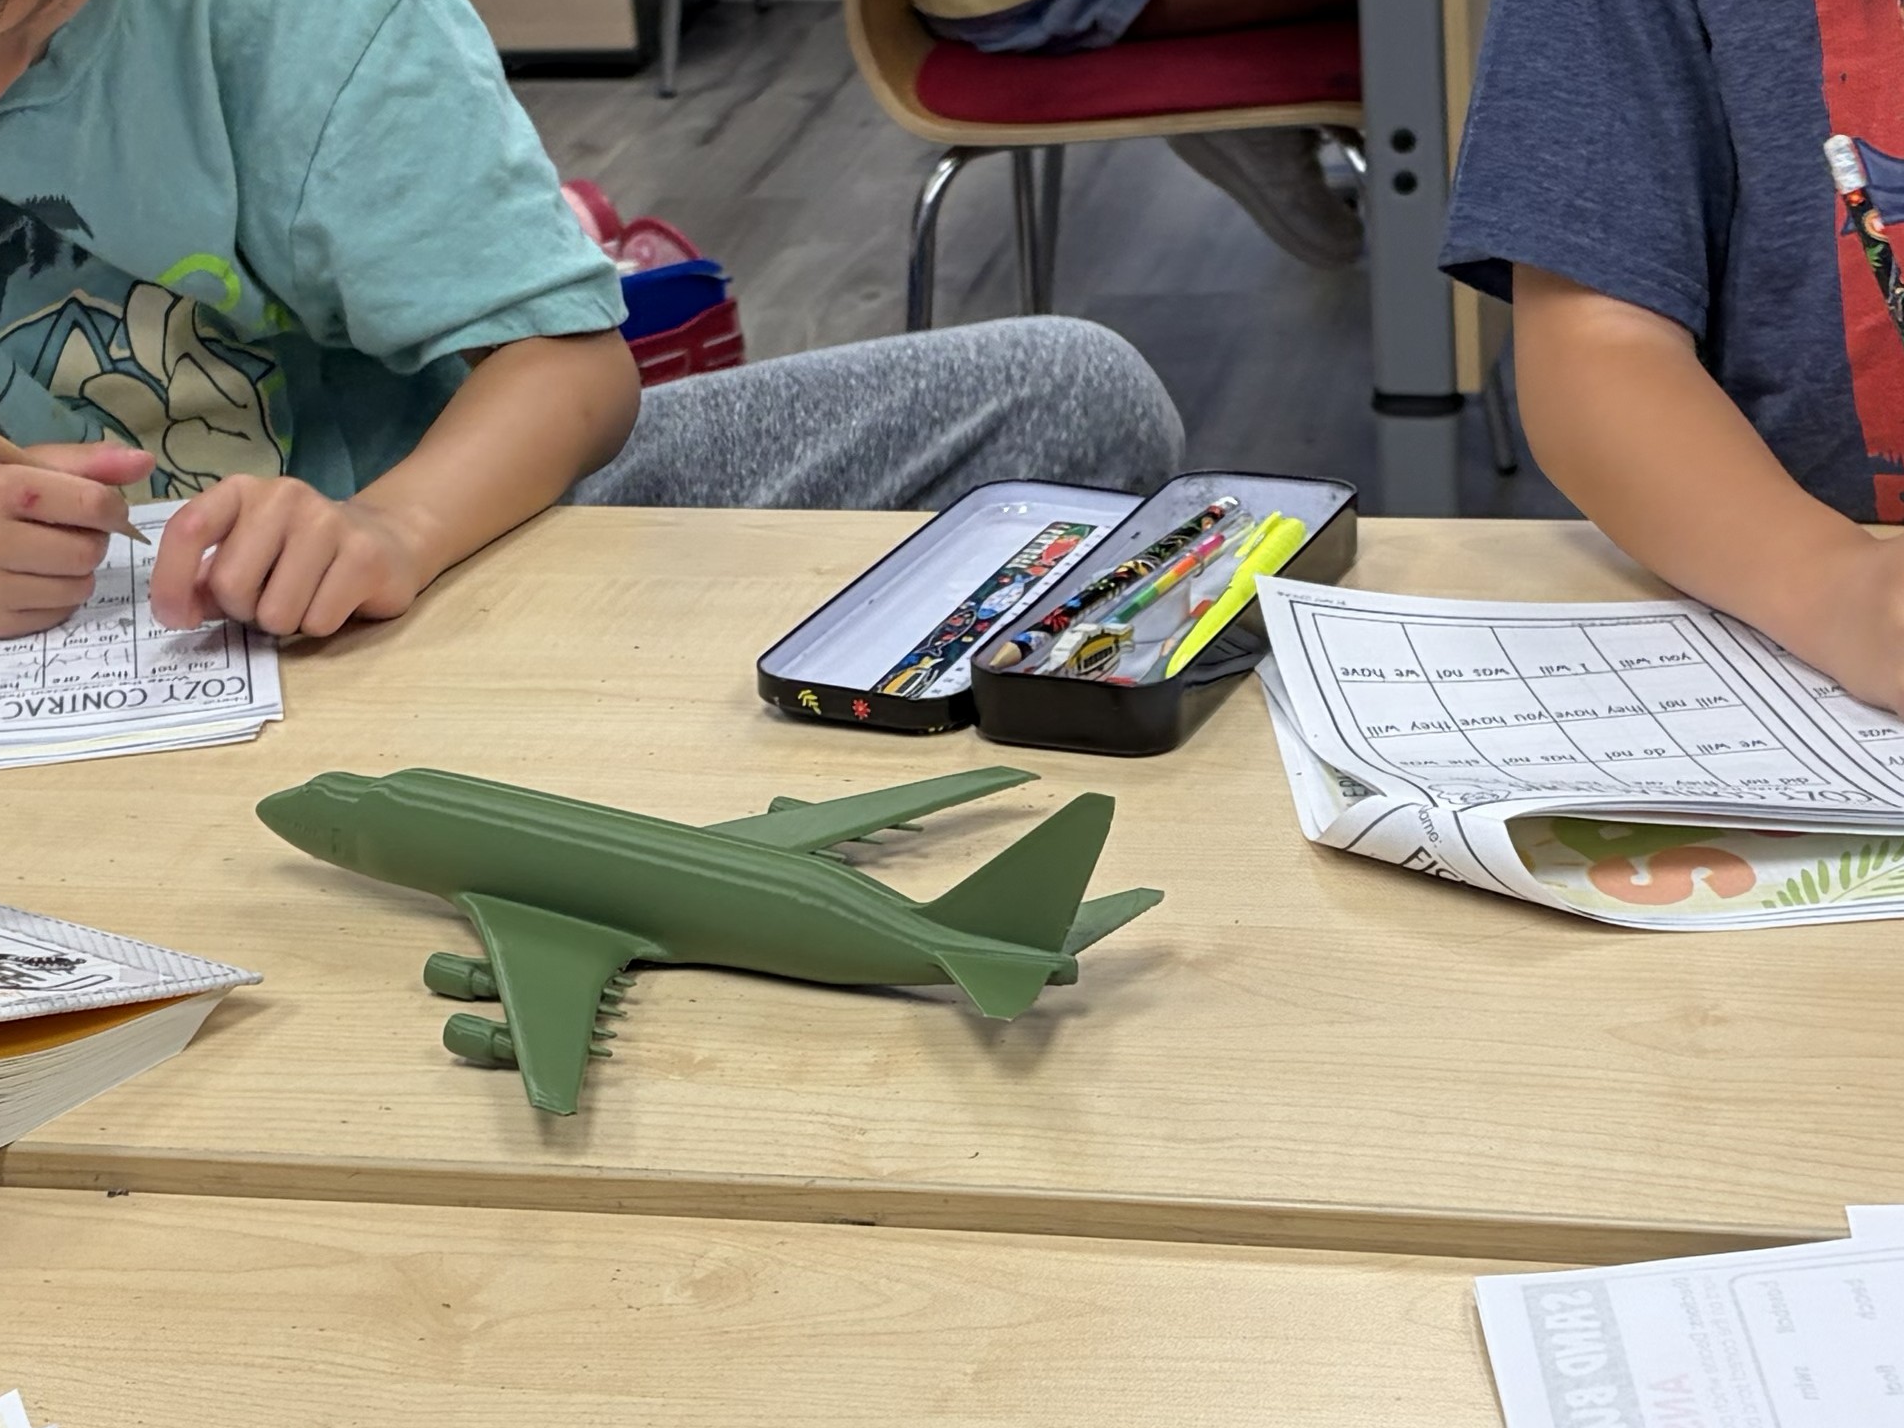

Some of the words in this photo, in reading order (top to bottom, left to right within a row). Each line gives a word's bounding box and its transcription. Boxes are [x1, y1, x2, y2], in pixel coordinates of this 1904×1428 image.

[1619, 658, 1656, 669] will
[1659, 652, 1696, 665] you
[1340, 667, 1390, 683] have
[1394, 669, 1420, 677] we
[1436, 670, 1463, 680] not
[1473, 668, 1513, 679] was
[1540, 665, 1576, 676] will
[162, 676, 245, 703] COZY
[1659, 700, 1692, 710] not
[1695, 696, 1733, 708] will
[1555, 709, 1602, 720] have
[1608, 705, 1646, 715] they
[1460, 716, 1510, 728] have
[1514, 711, 1552, 724] you
[1367, 725, 1404, 737] will
[1411, 721, 1454, 732] they
[1697, 743, 1734, 754] will
[1740, 740, 1767, 748] we
[1605, 750, 1638, 760] not
[1644, 748, 1671, 757] do
[1502, 757, 1530, 766] not
